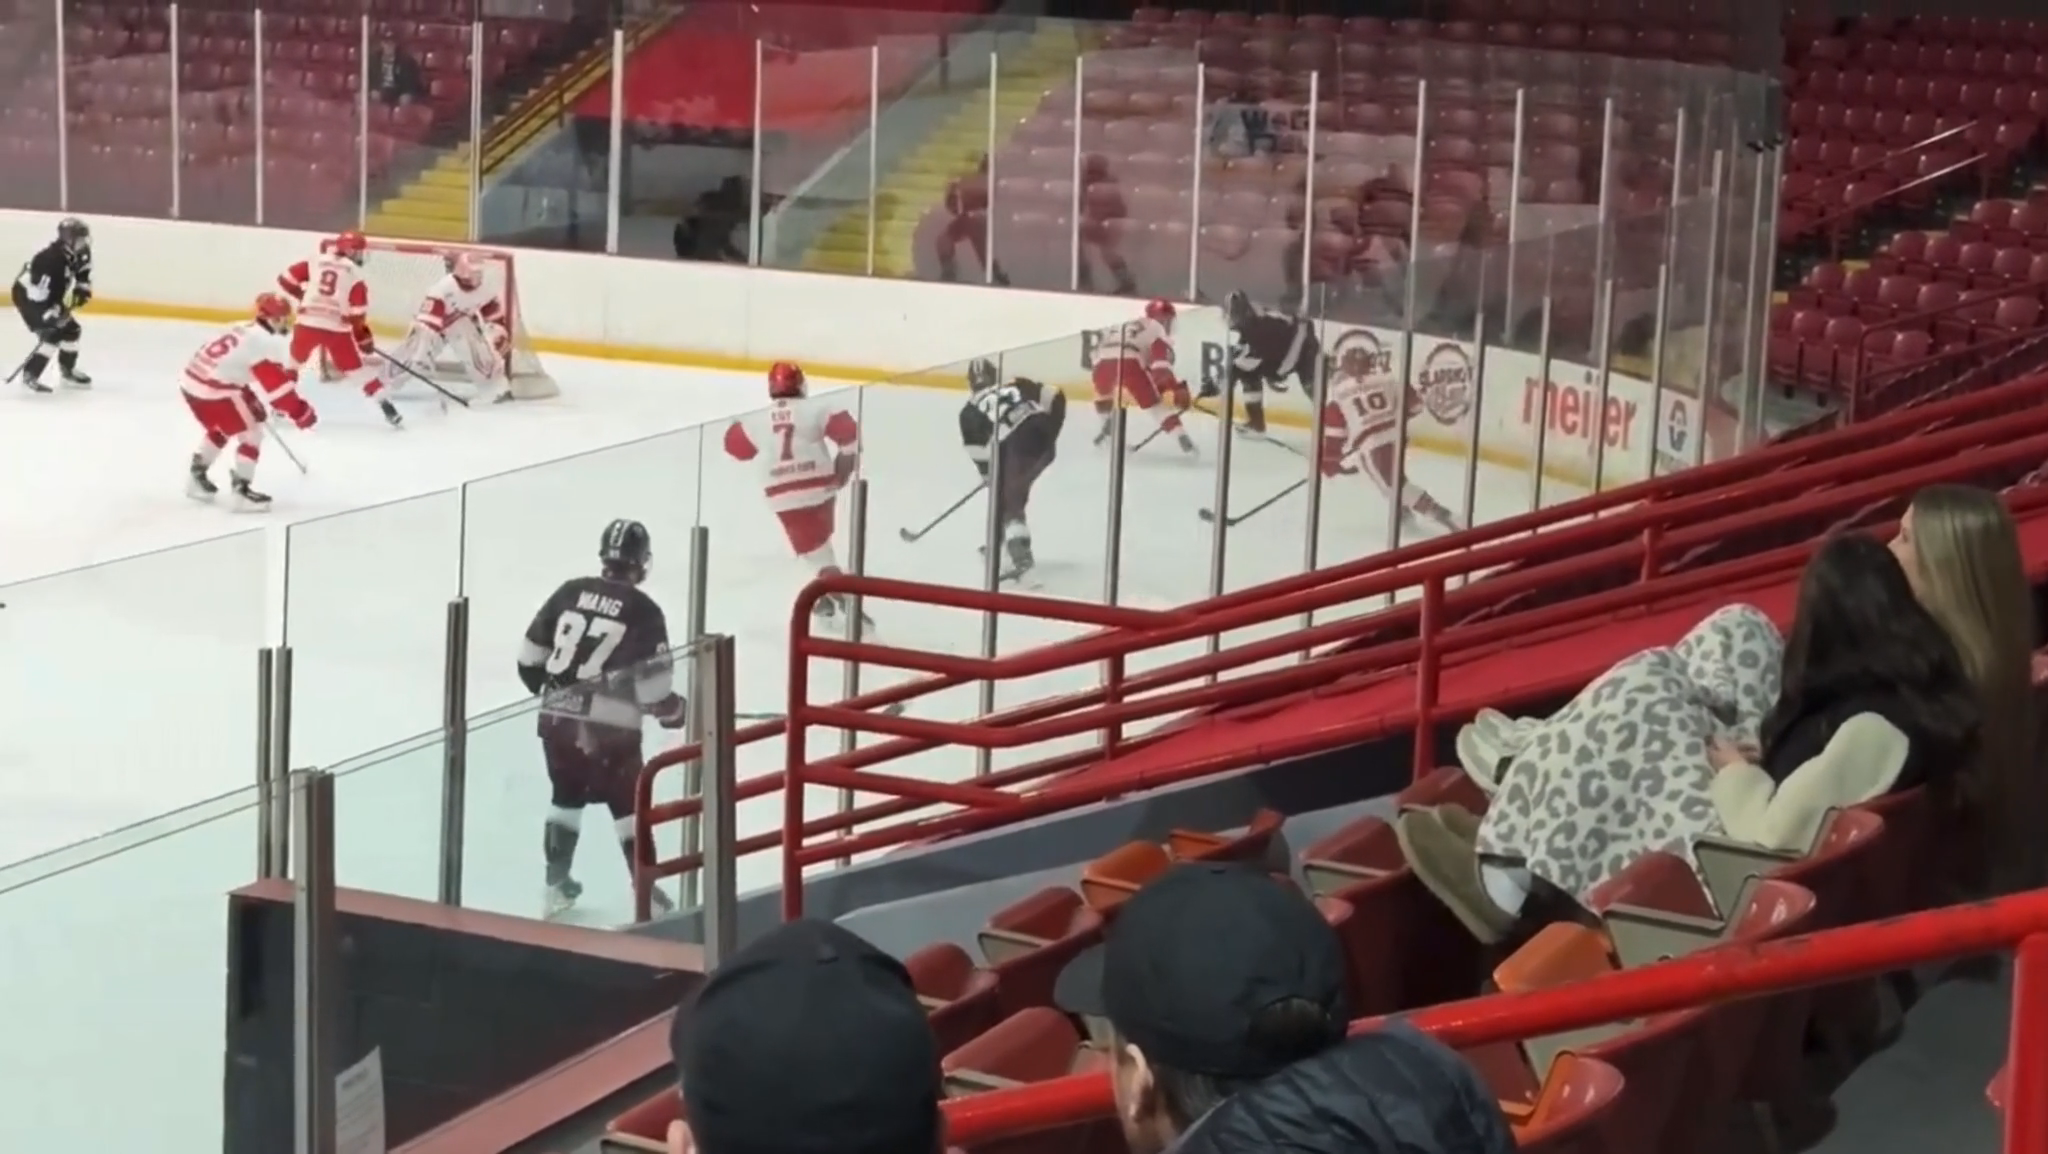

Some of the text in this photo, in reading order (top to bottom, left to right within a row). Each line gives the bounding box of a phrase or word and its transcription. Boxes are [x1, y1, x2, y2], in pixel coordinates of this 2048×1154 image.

[319, 270, 338, 296] 9
[1353, 392, 1388, 418] 10
[1522, 370, 1637, 455] meijer
[773, 423, 794, 461] 7
[576, 590, 623, 617] WANG
[545, 609, 627, 680] 87
